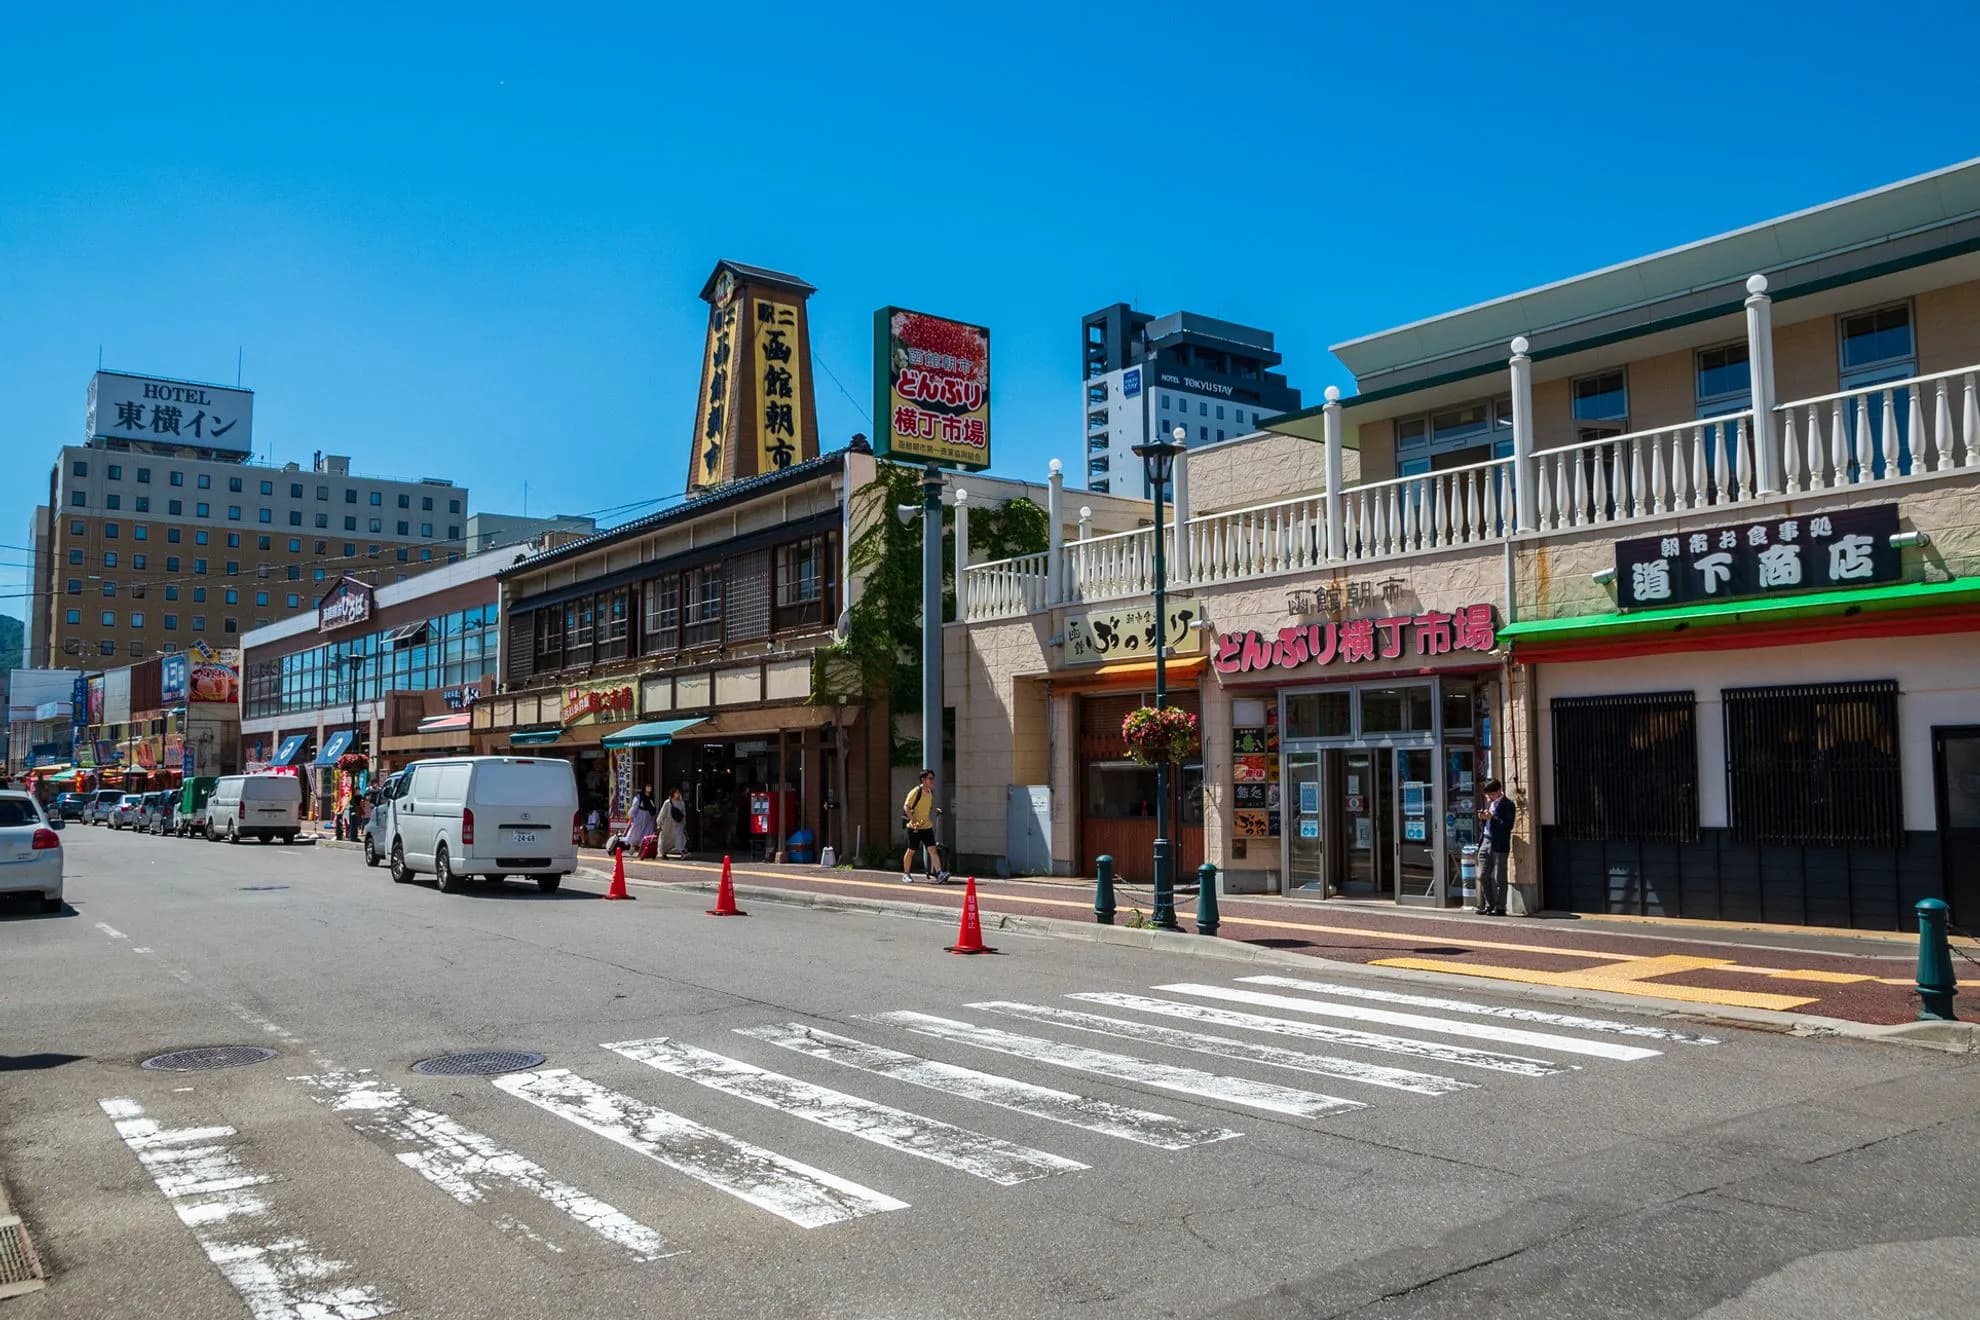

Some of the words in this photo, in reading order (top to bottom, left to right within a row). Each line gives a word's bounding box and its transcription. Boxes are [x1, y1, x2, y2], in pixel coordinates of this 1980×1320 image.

[907, 349, 972, 374] 函館朝市
[1161, 373, 1180, 384] HOTEL
[143, 383, 211, 406] HOTEL
[763, 330, 796, 472] 函館朝市
[896, 369, 983, 411] どんぶり
[112, 400, 238, 439] 東横イン
[893, 406, 987, 448] 横丁市場
[1660, 516, 1833, 558] 朝市お食事処
[1632, 534, 1875, 601] 道下商店
[1286, 577, 1405, 616] 函館朝市
[1214, 603, 1496, 674] どんぶり横丁市場
